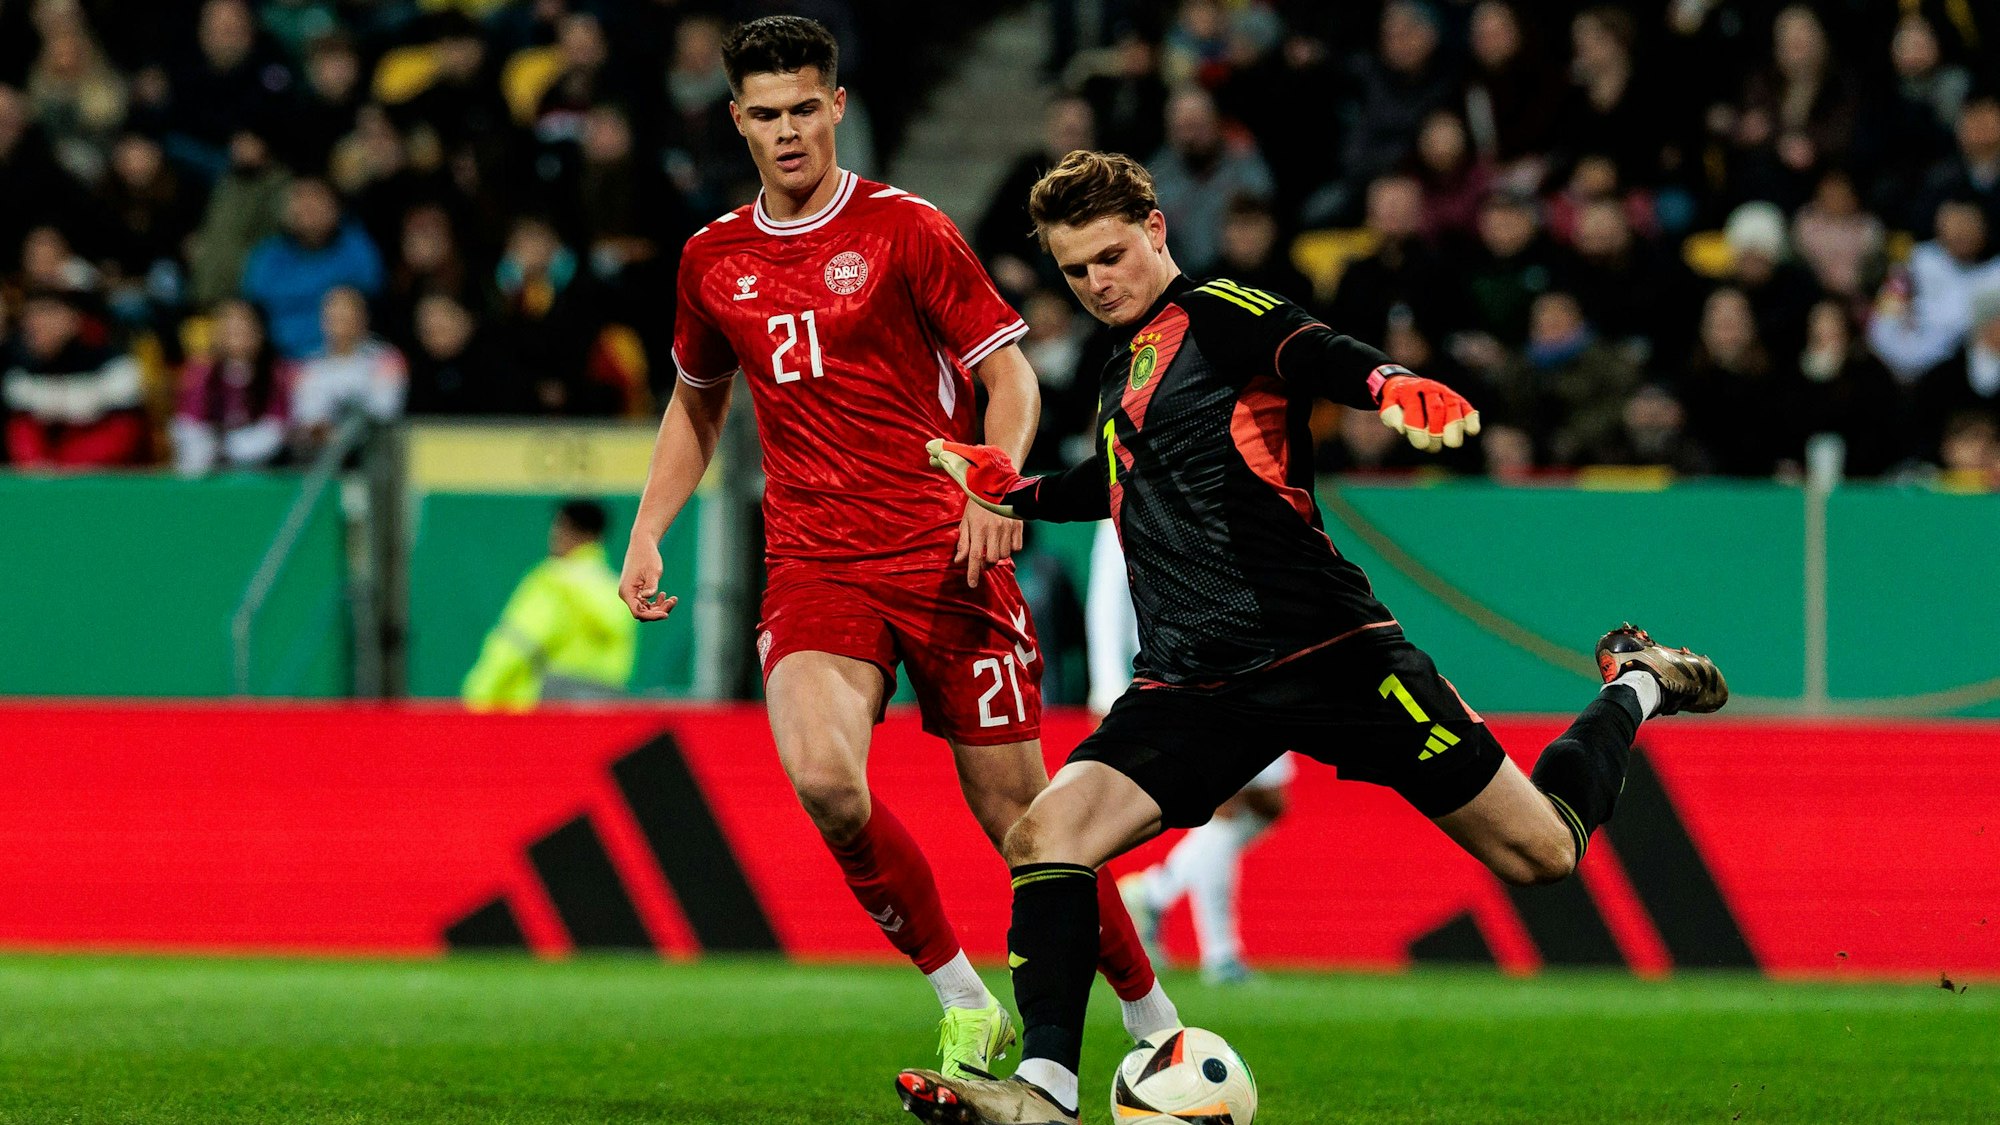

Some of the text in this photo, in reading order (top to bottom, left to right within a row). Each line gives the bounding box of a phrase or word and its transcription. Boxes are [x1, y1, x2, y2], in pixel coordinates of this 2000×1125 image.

[834, 265, 858, 280] DBU
[767, 310, 824, 384] 21
[1103, 418, 1117, 485] 1
[973, 654, 1026, 727] 21
[1378, 673, 1431, 722] 1
